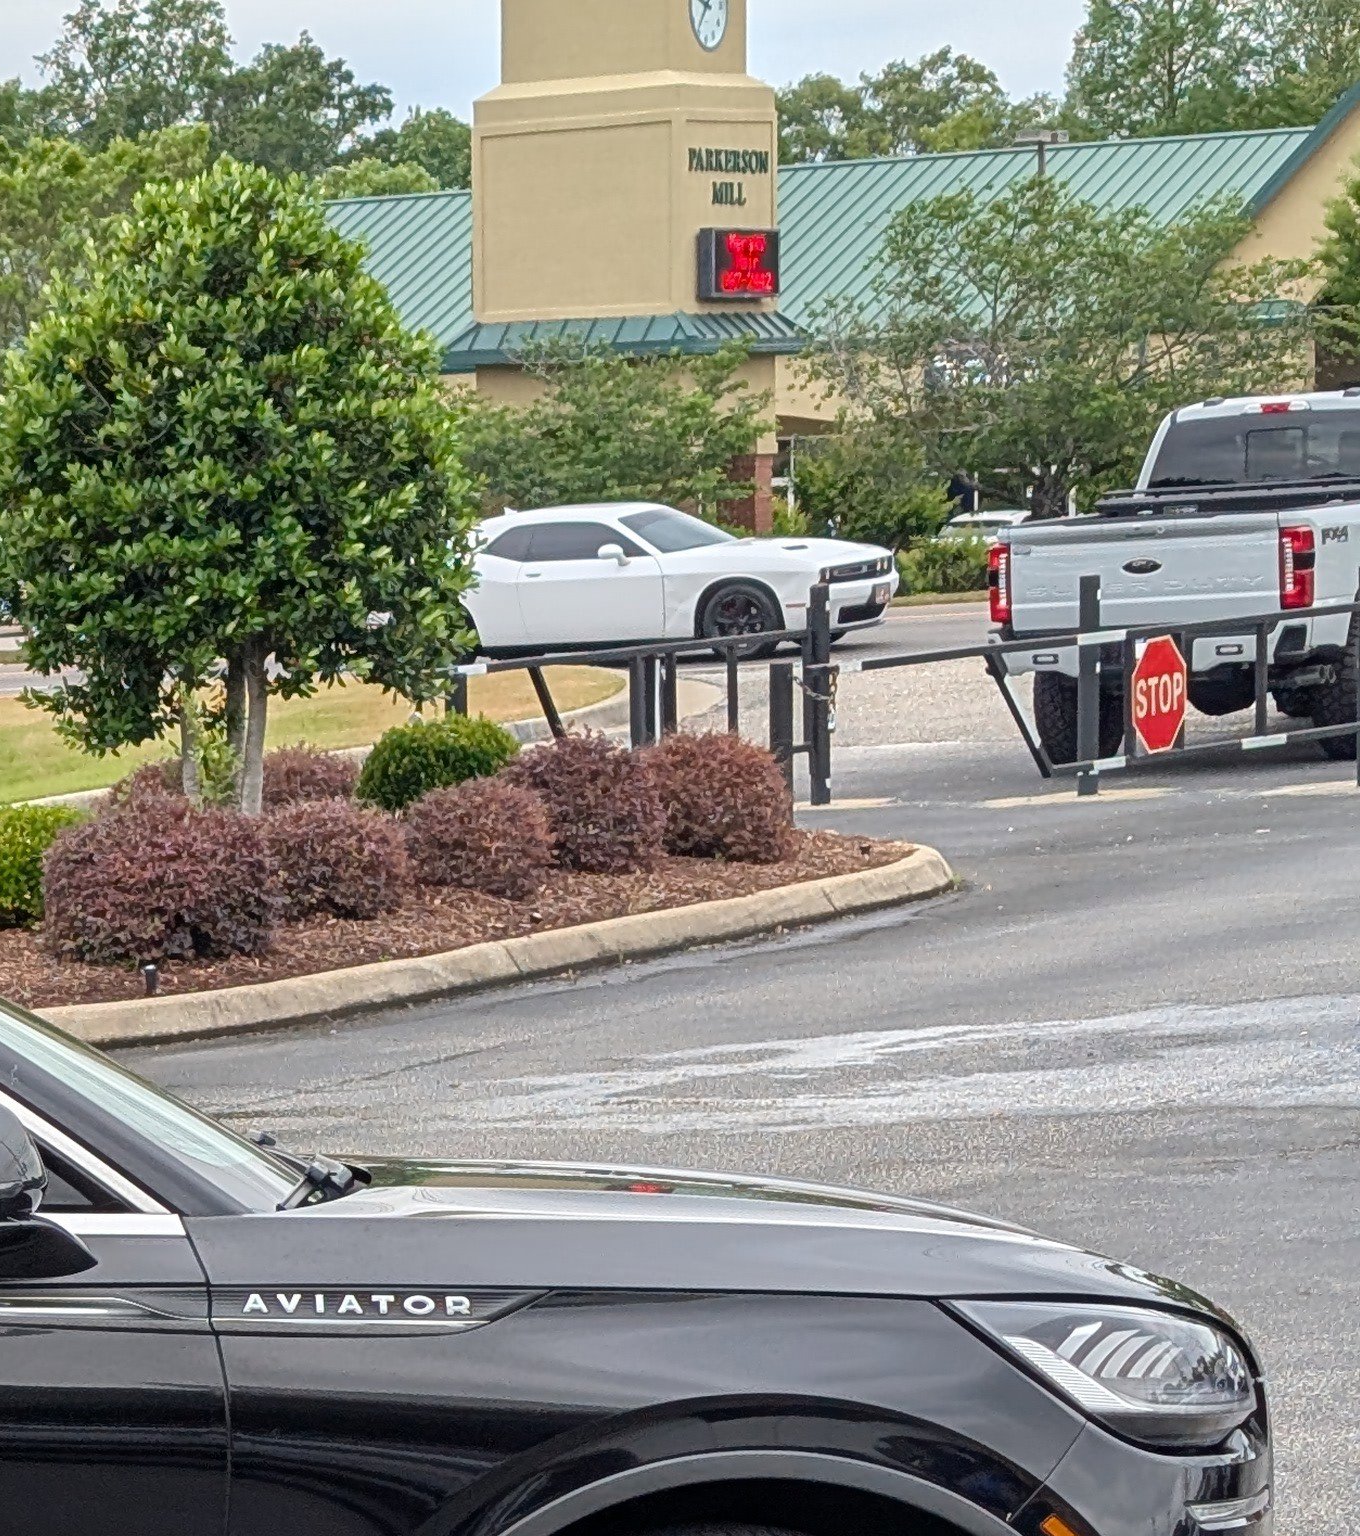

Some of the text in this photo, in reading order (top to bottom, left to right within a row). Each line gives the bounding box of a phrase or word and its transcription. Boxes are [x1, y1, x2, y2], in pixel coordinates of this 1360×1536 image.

[687, 147, 769, 174] PARKERSON
[711, 181, 747, 206] MILL
[1136, 671, 1183, 719] STOP
[242, 1293, 472, 1316] AVIATOR
